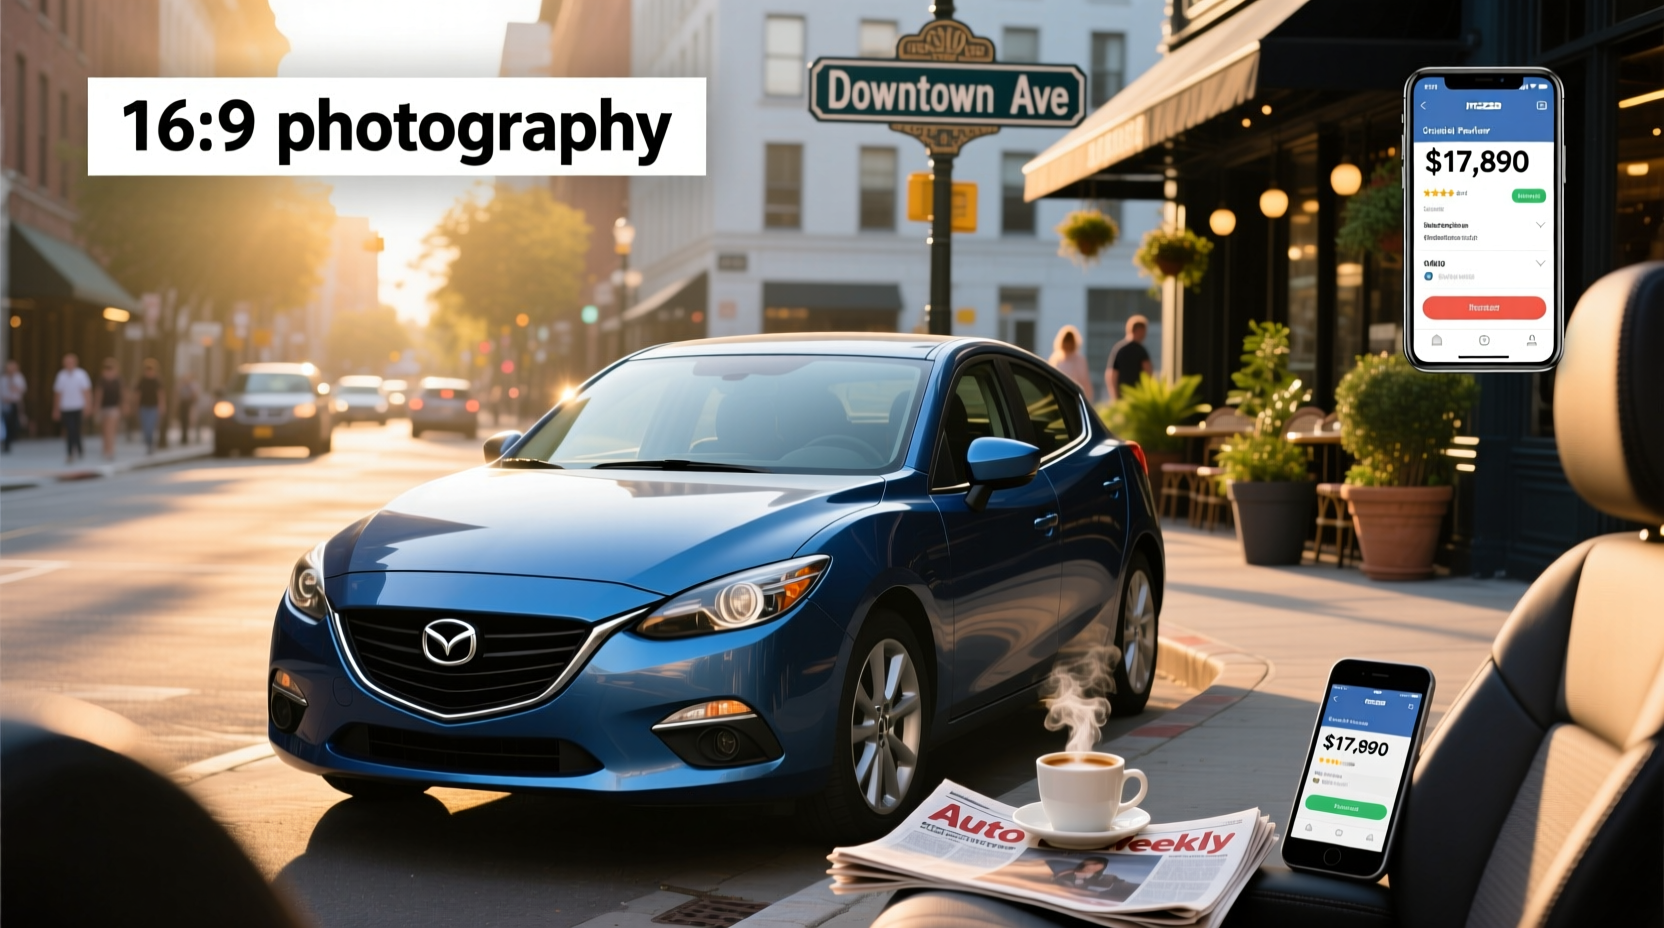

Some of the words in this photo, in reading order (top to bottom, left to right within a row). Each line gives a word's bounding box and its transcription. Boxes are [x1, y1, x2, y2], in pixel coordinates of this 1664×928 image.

[828, 69, 995, 114] Downtown
[1009, 74, 1070, 116] Ave
[1425, 147, 1529, 178] $17,890
[928, 803, 1026, 843] Auto
